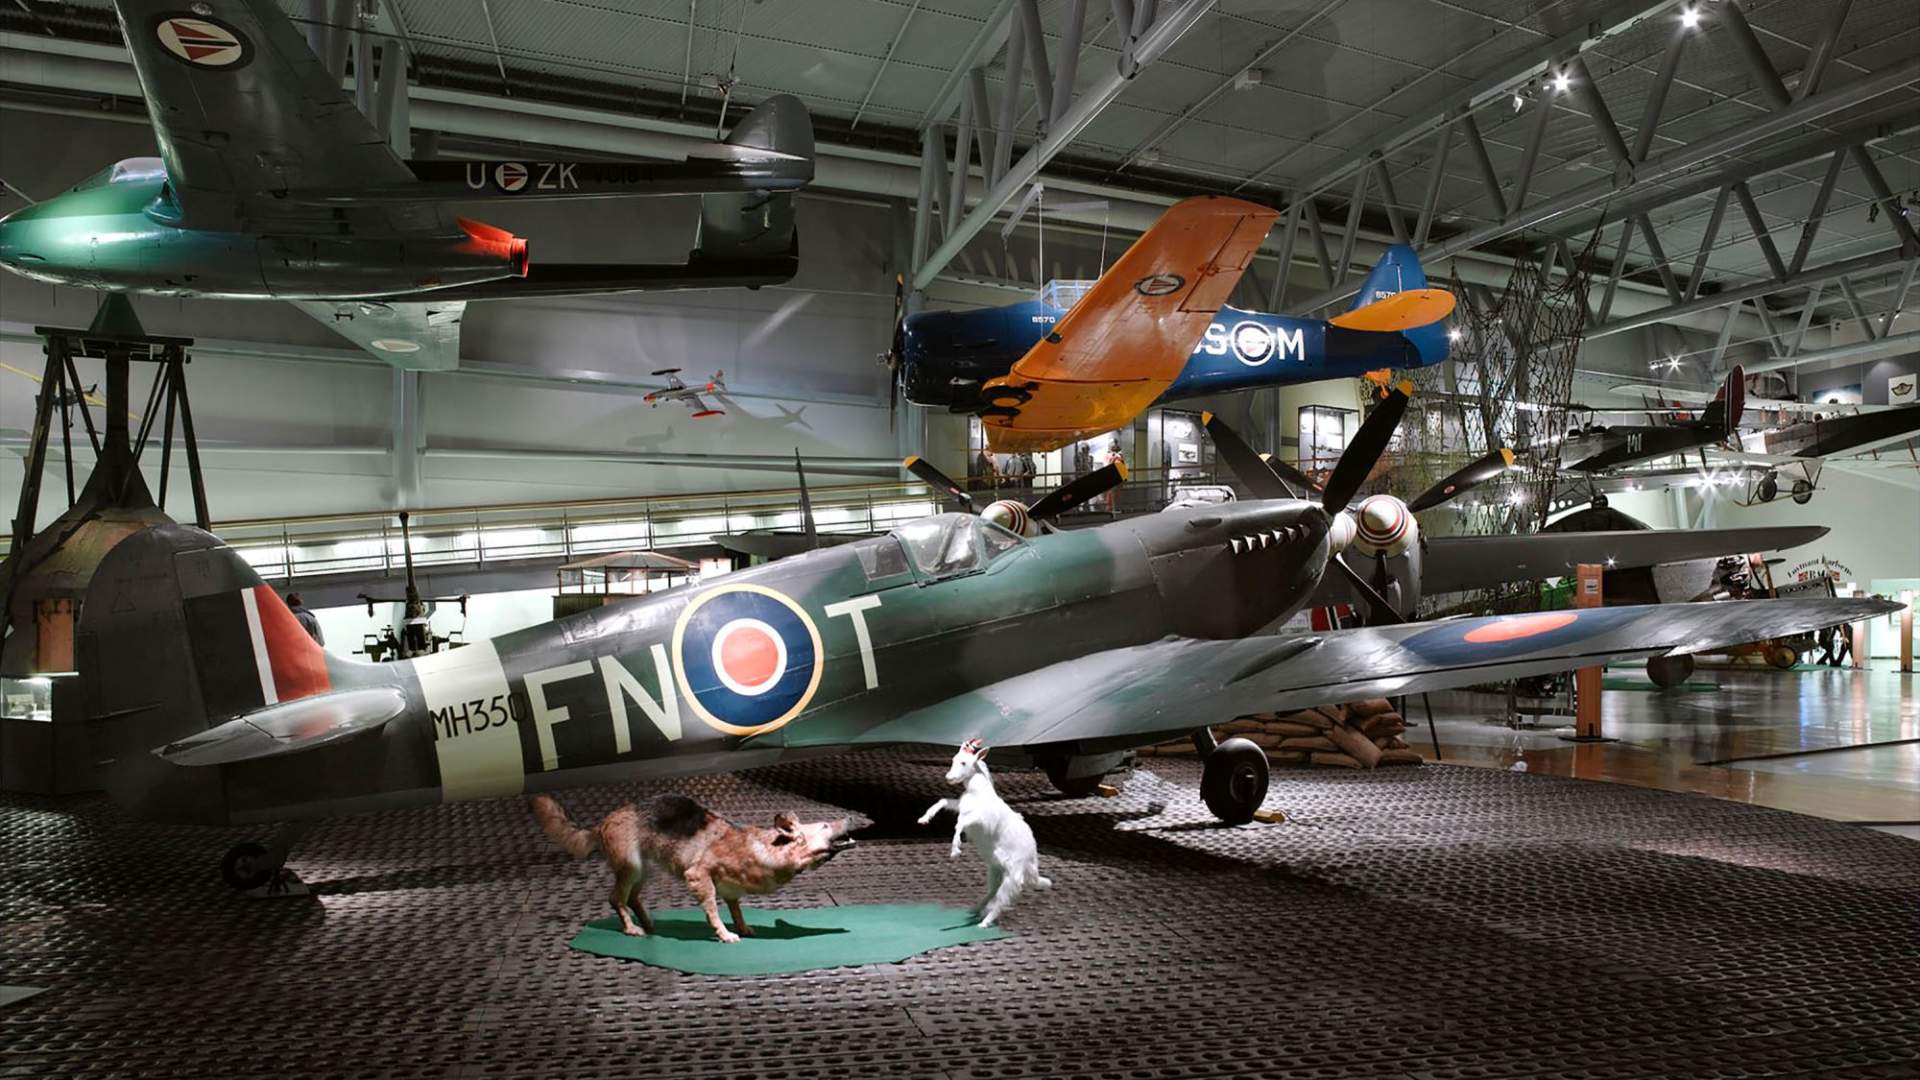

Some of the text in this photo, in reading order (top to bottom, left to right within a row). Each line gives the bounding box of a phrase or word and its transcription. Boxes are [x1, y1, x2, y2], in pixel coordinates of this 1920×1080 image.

[466, 163, 579, 189] U ZK
[1193, 323, 1305, 361] S M
[523, 594, 882, 771] FN T
[429, 692, 526, 741] MH350
